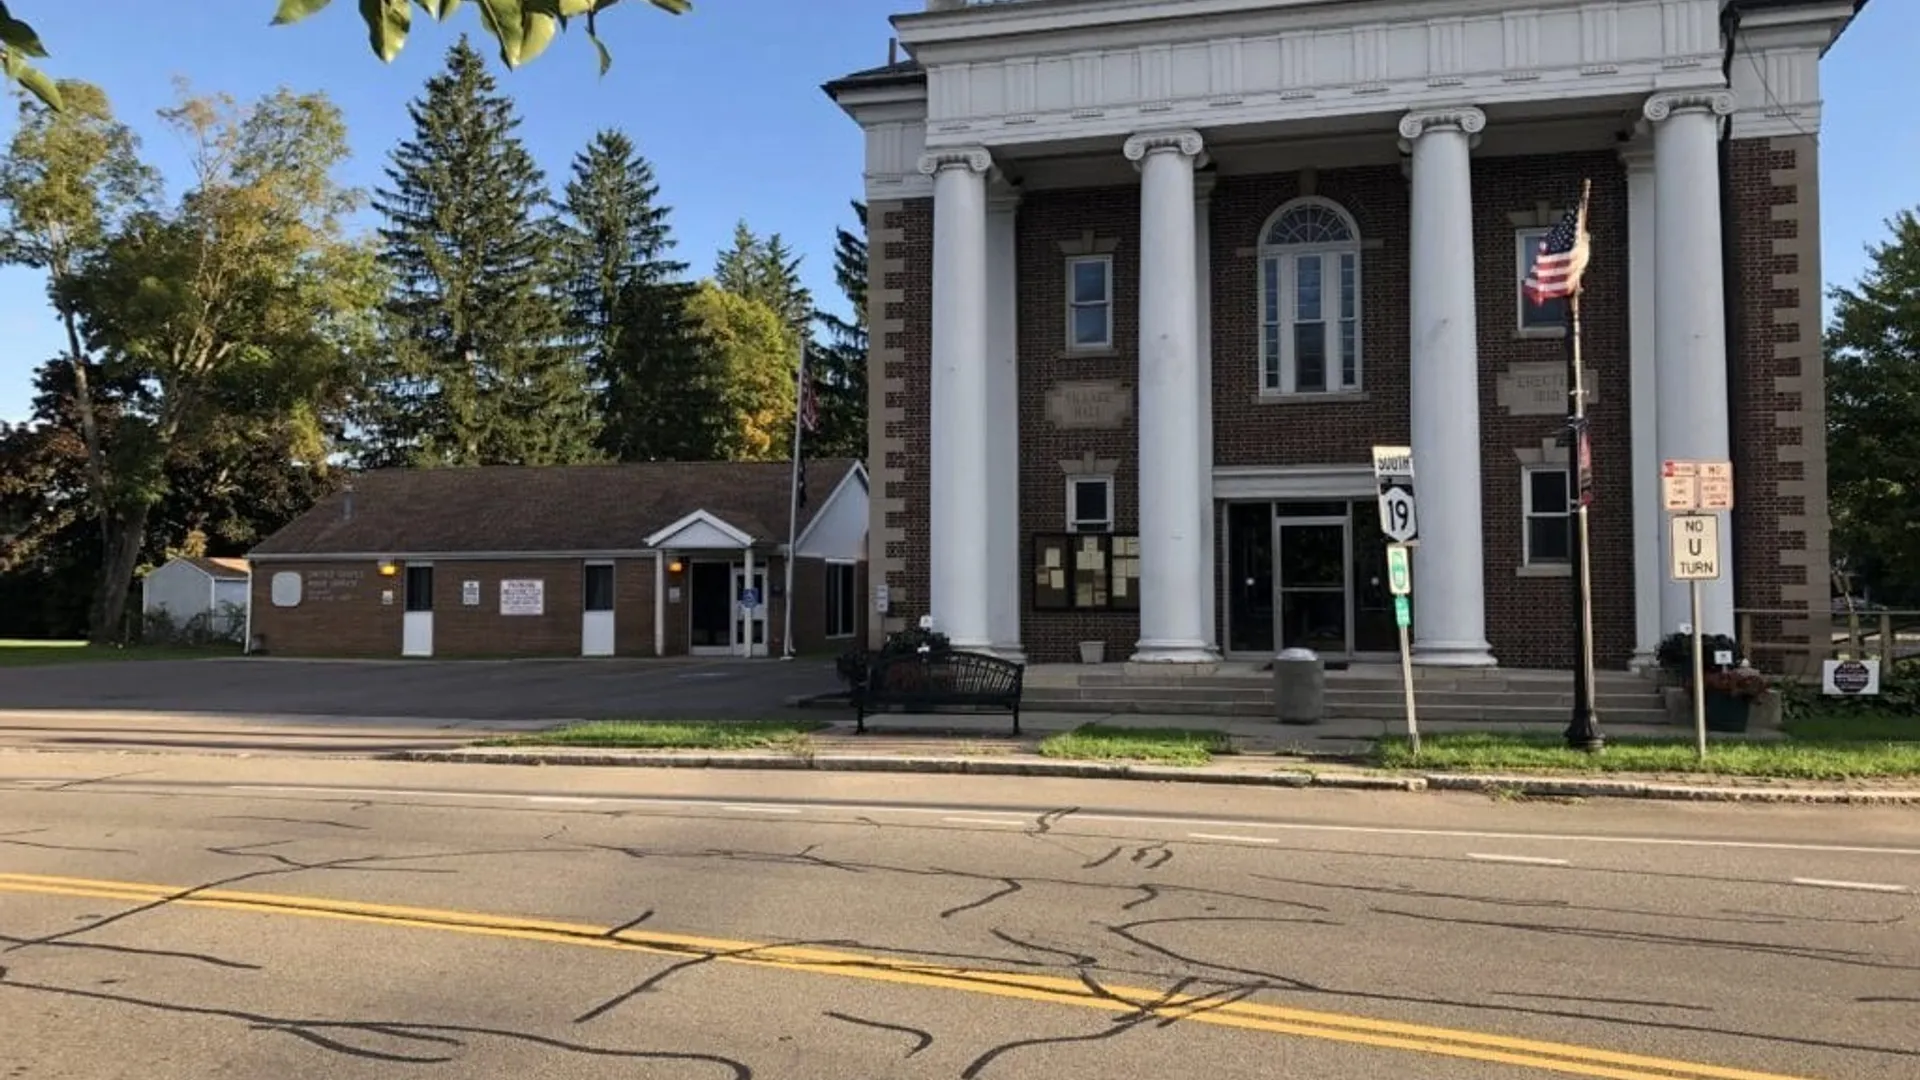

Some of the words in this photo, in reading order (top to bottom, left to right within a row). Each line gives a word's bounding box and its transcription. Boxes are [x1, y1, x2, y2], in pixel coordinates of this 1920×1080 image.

[1379, 455, 1410, 470] SOUTH
[1388, 499, 1408, 532] 19
[1685, 519, 1704, 532] NO
[1689, 538, 1702, 556] U
[1680, 561, 1714, 575] TURN
